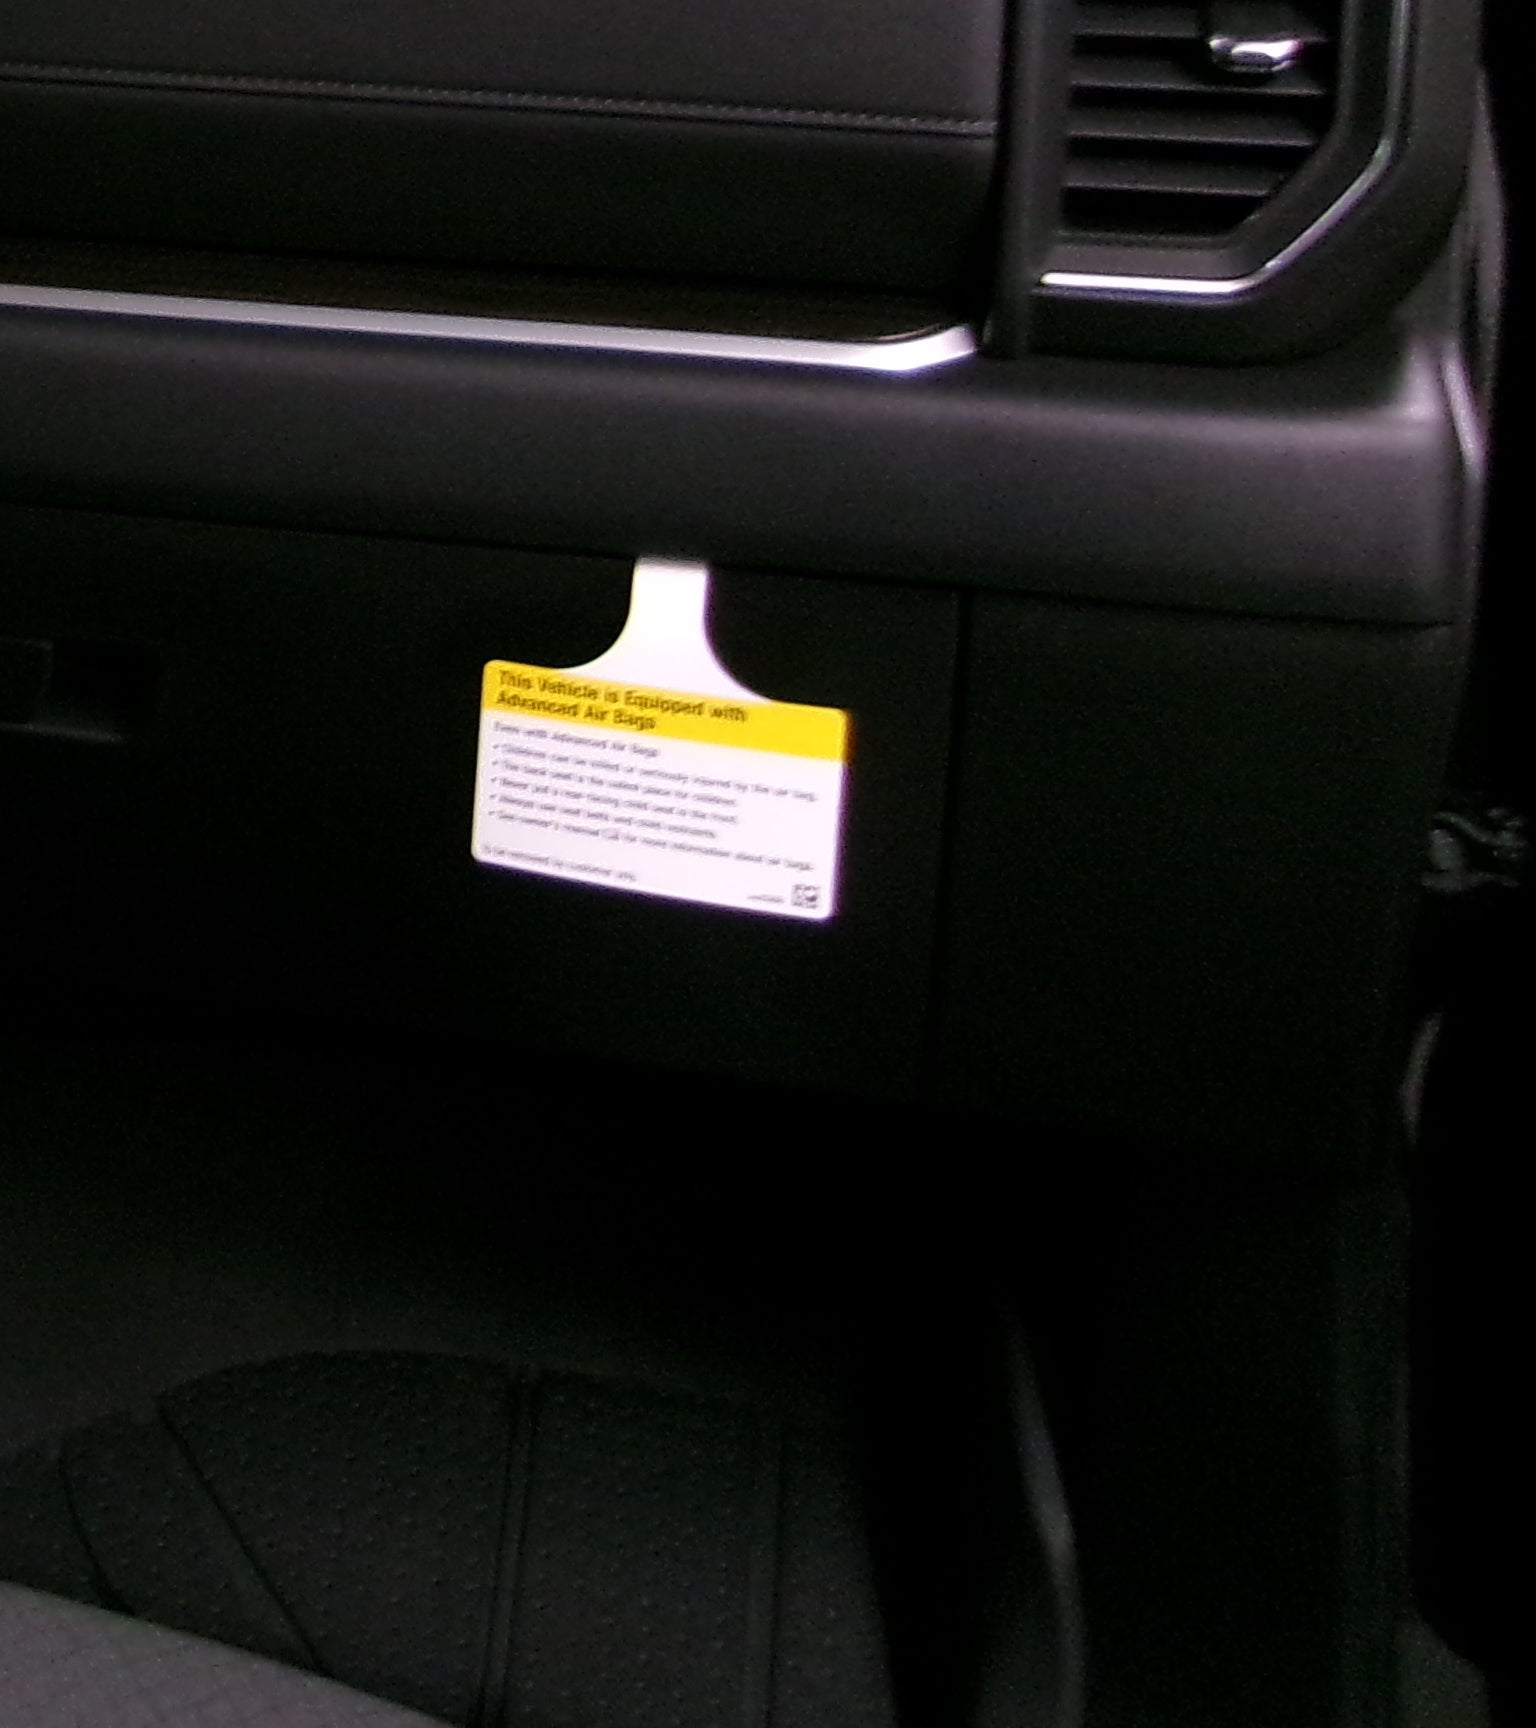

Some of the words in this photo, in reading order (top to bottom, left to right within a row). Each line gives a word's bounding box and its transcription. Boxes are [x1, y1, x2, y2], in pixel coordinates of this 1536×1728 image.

[496, 691, 579, 717] Advanced
[584, 705, 608, 721] Air
[613, 710, 656, 732] Bags
[498, 671, 532, 689] This
[537, 678, 599, 700] Vehicle
[604, 690, 619, 703] is
[624, 690, 705, 717] Equipped
[709, 703, 748, 722] with
